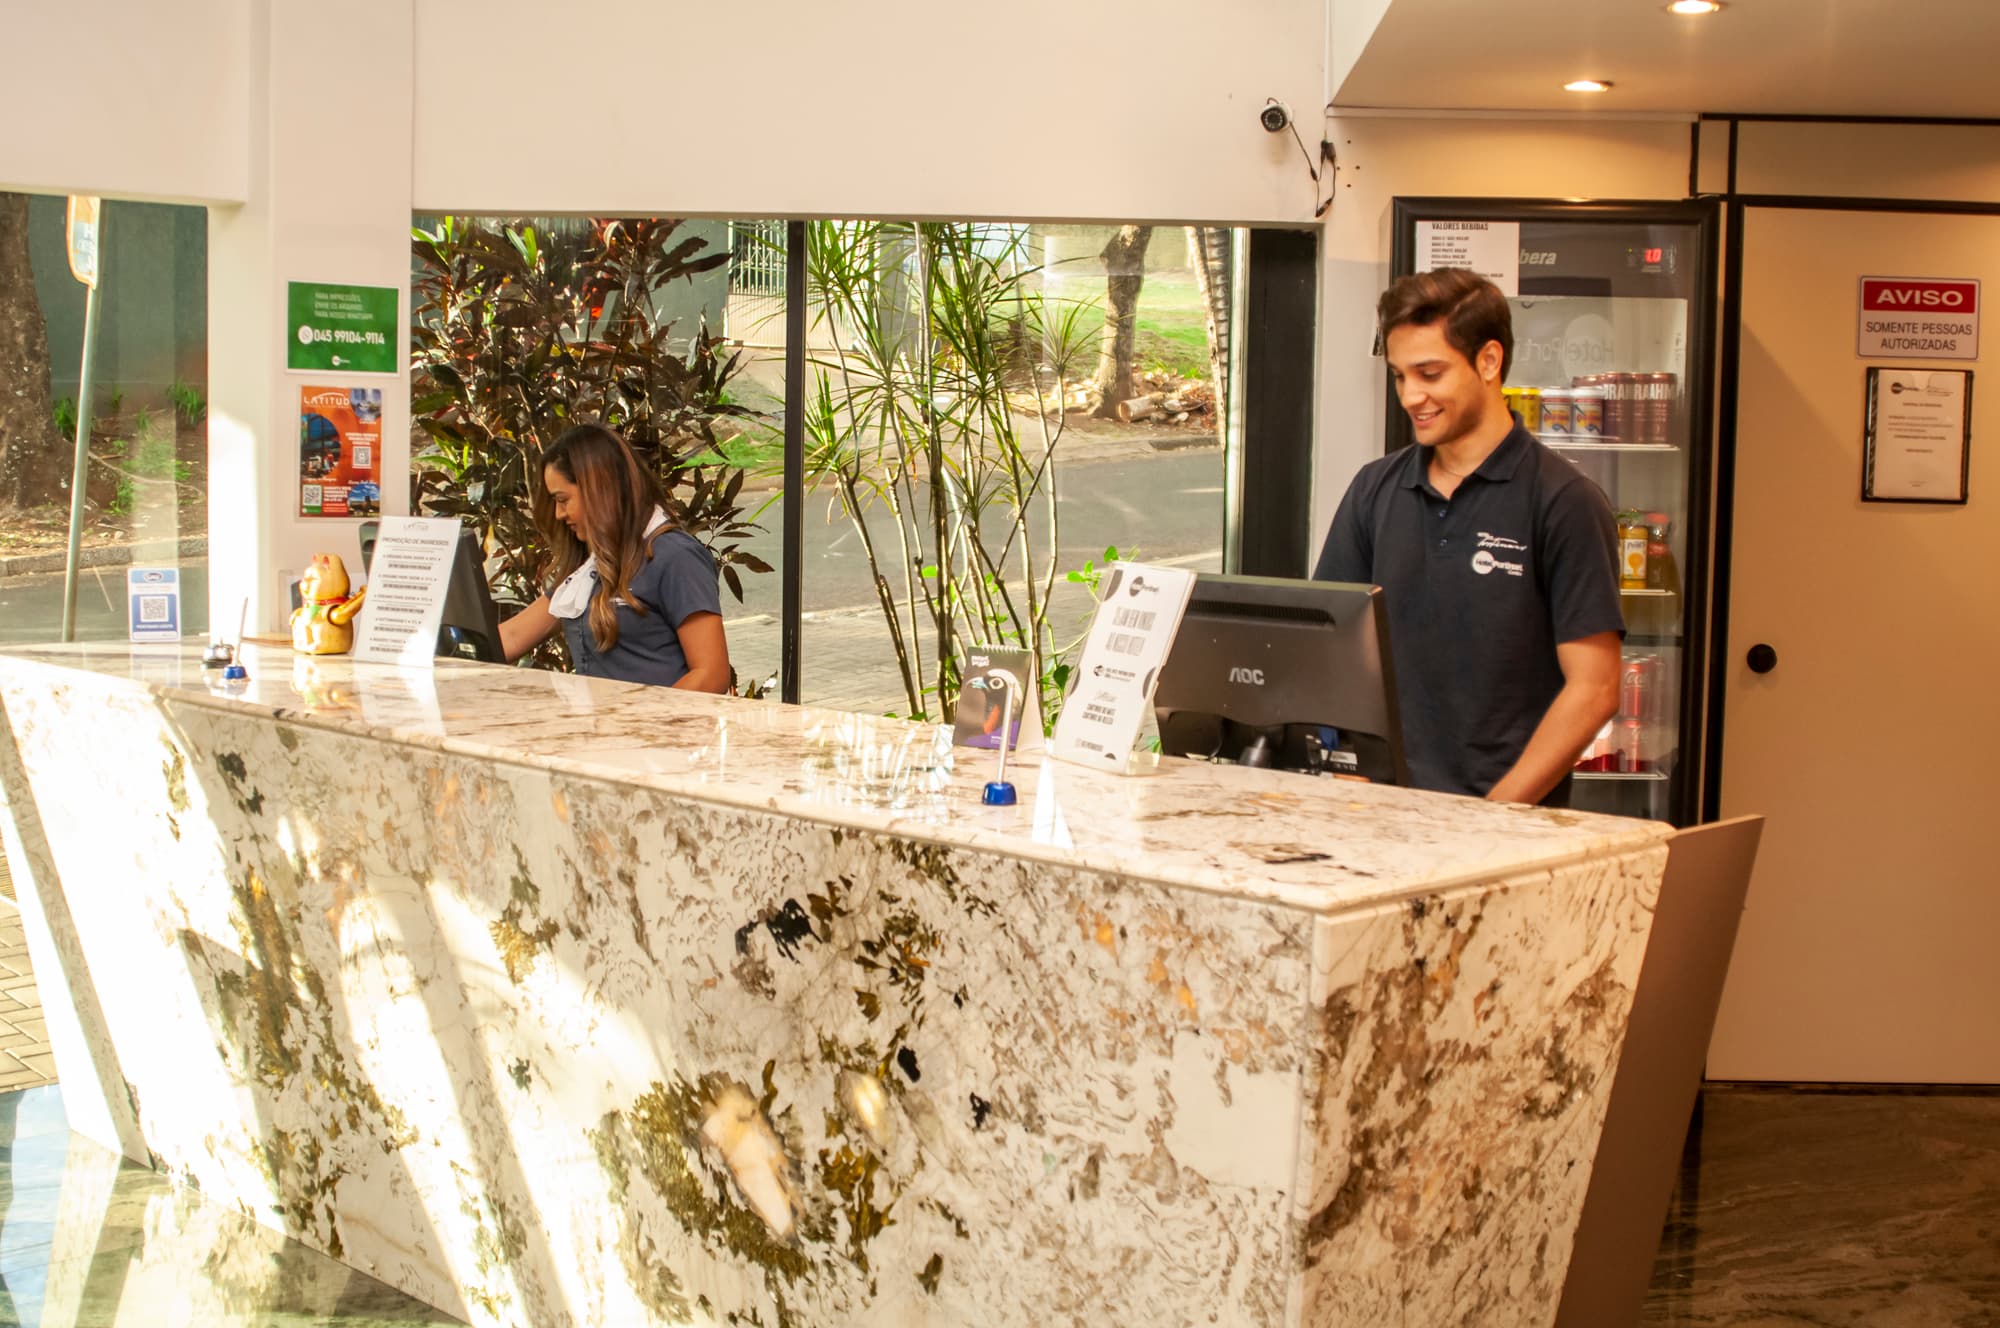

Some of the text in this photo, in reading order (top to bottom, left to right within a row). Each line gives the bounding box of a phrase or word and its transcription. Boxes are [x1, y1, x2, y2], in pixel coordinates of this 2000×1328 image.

[1431, 223, 1489, 231] VALORES BEBIDAS
[1519, 249, 1557, 265] bera
[1876, 289, 1963, 306] AVISO
[1866, 321, 1973, 336] SOMENTE PESSOAS
[313, 329, 385, 344] 045 99104-9114
[1881, 338, 1957, 351] AUTORIZADAS
[1229, 667, 1264, 685] AOC
